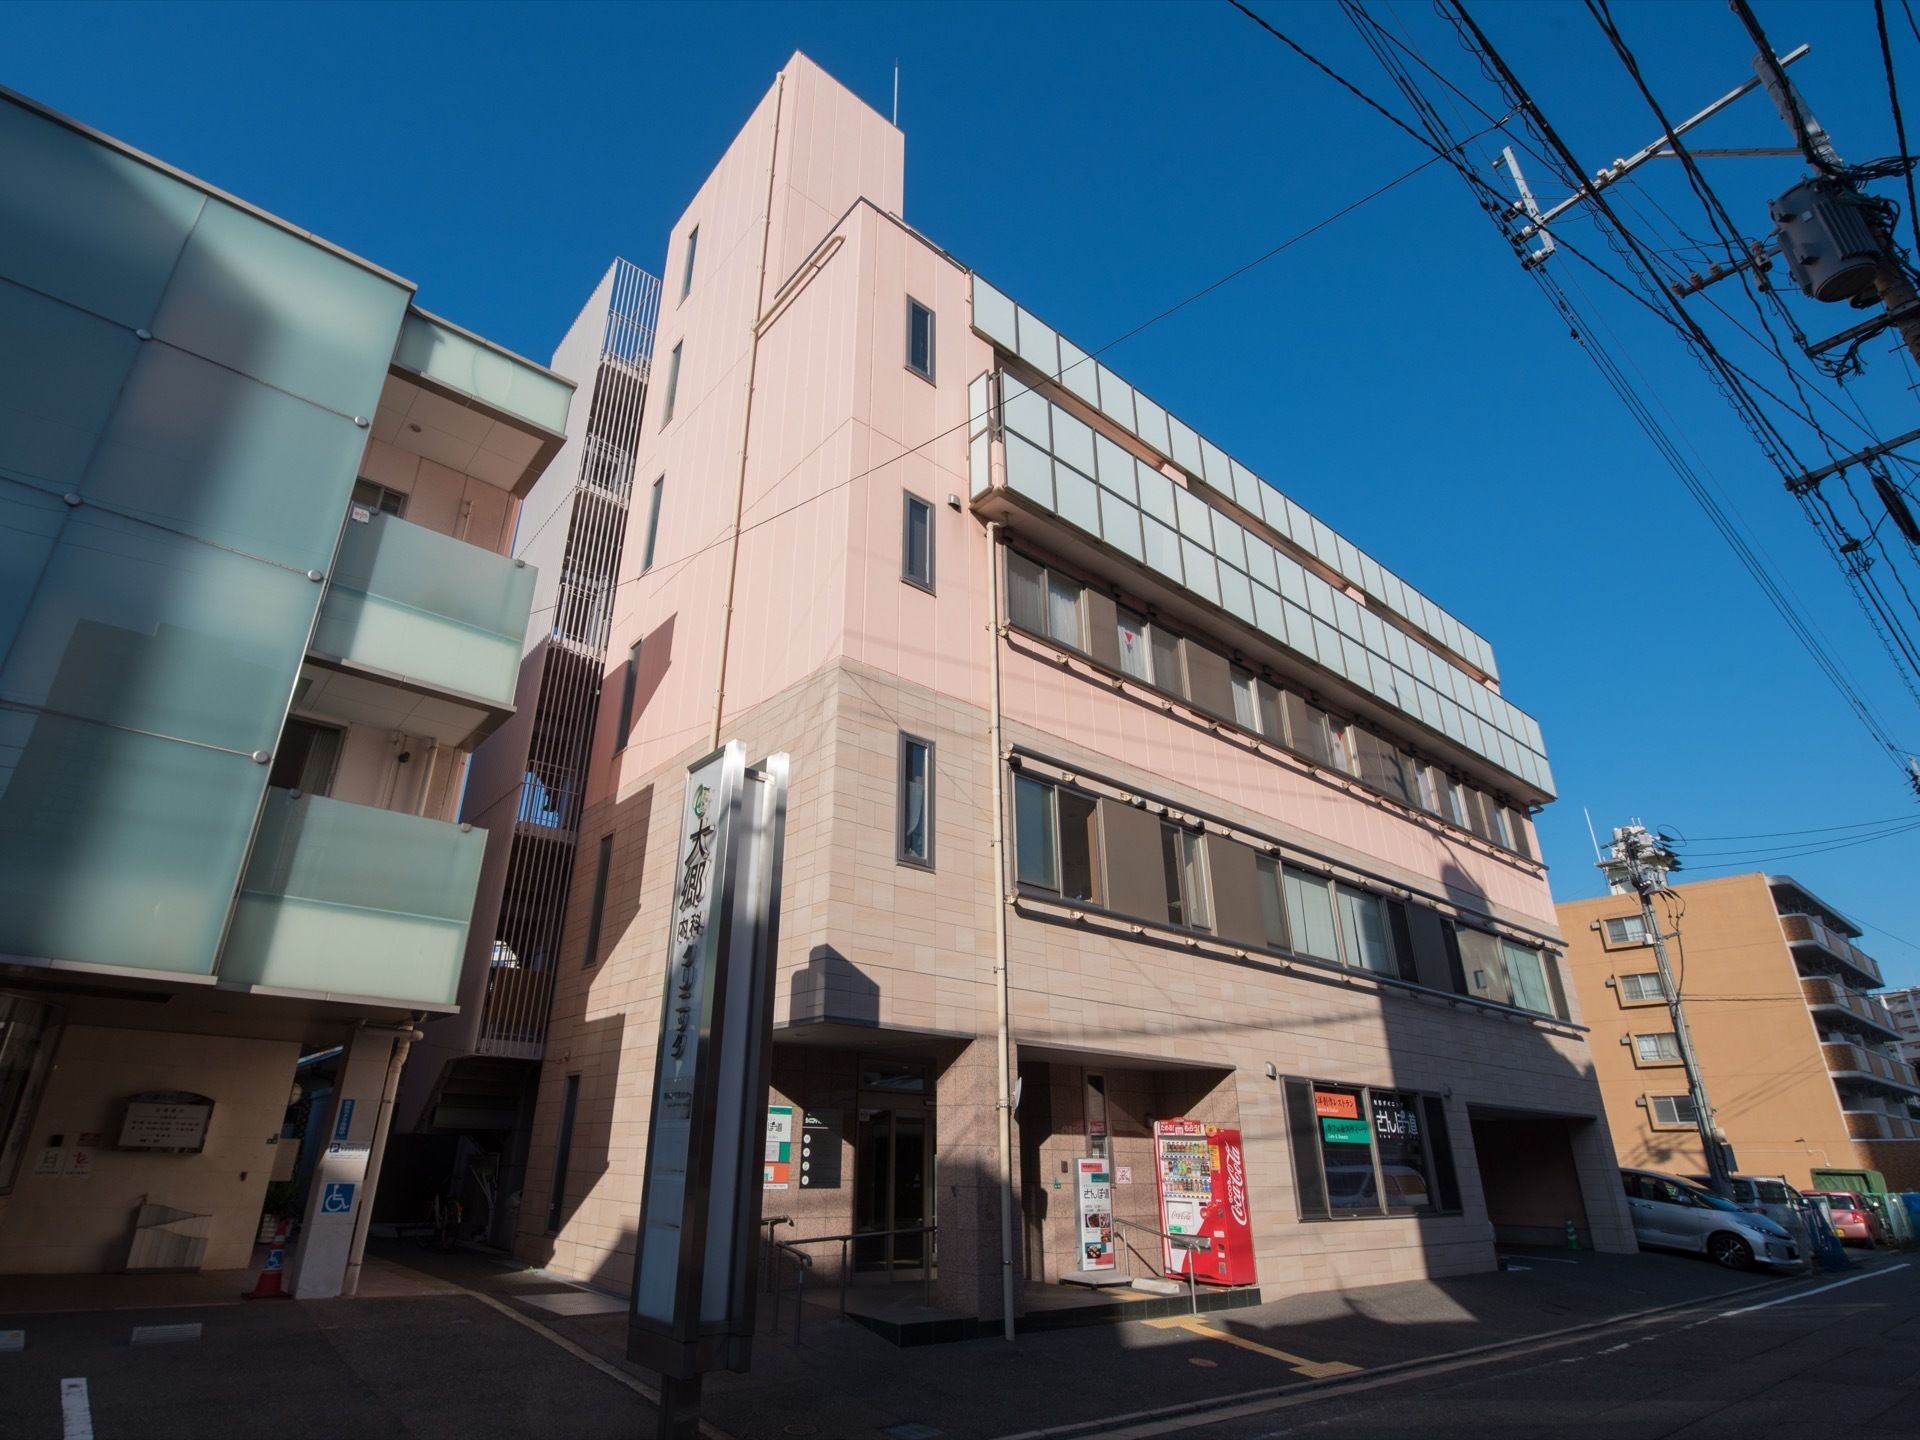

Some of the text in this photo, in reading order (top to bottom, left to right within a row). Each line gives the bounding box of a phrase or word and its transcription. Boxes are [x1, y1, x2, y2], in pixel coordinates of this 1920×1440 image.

[680, 818, 715, 911] 大郷
[677, 913, 704, 944] 内科
[671, 945, 696, 1060] クリニック
[1376, 1109, 1419, 1135] さんぽ道
[1225, 1141, 1247, 1226] Coca-Cola
